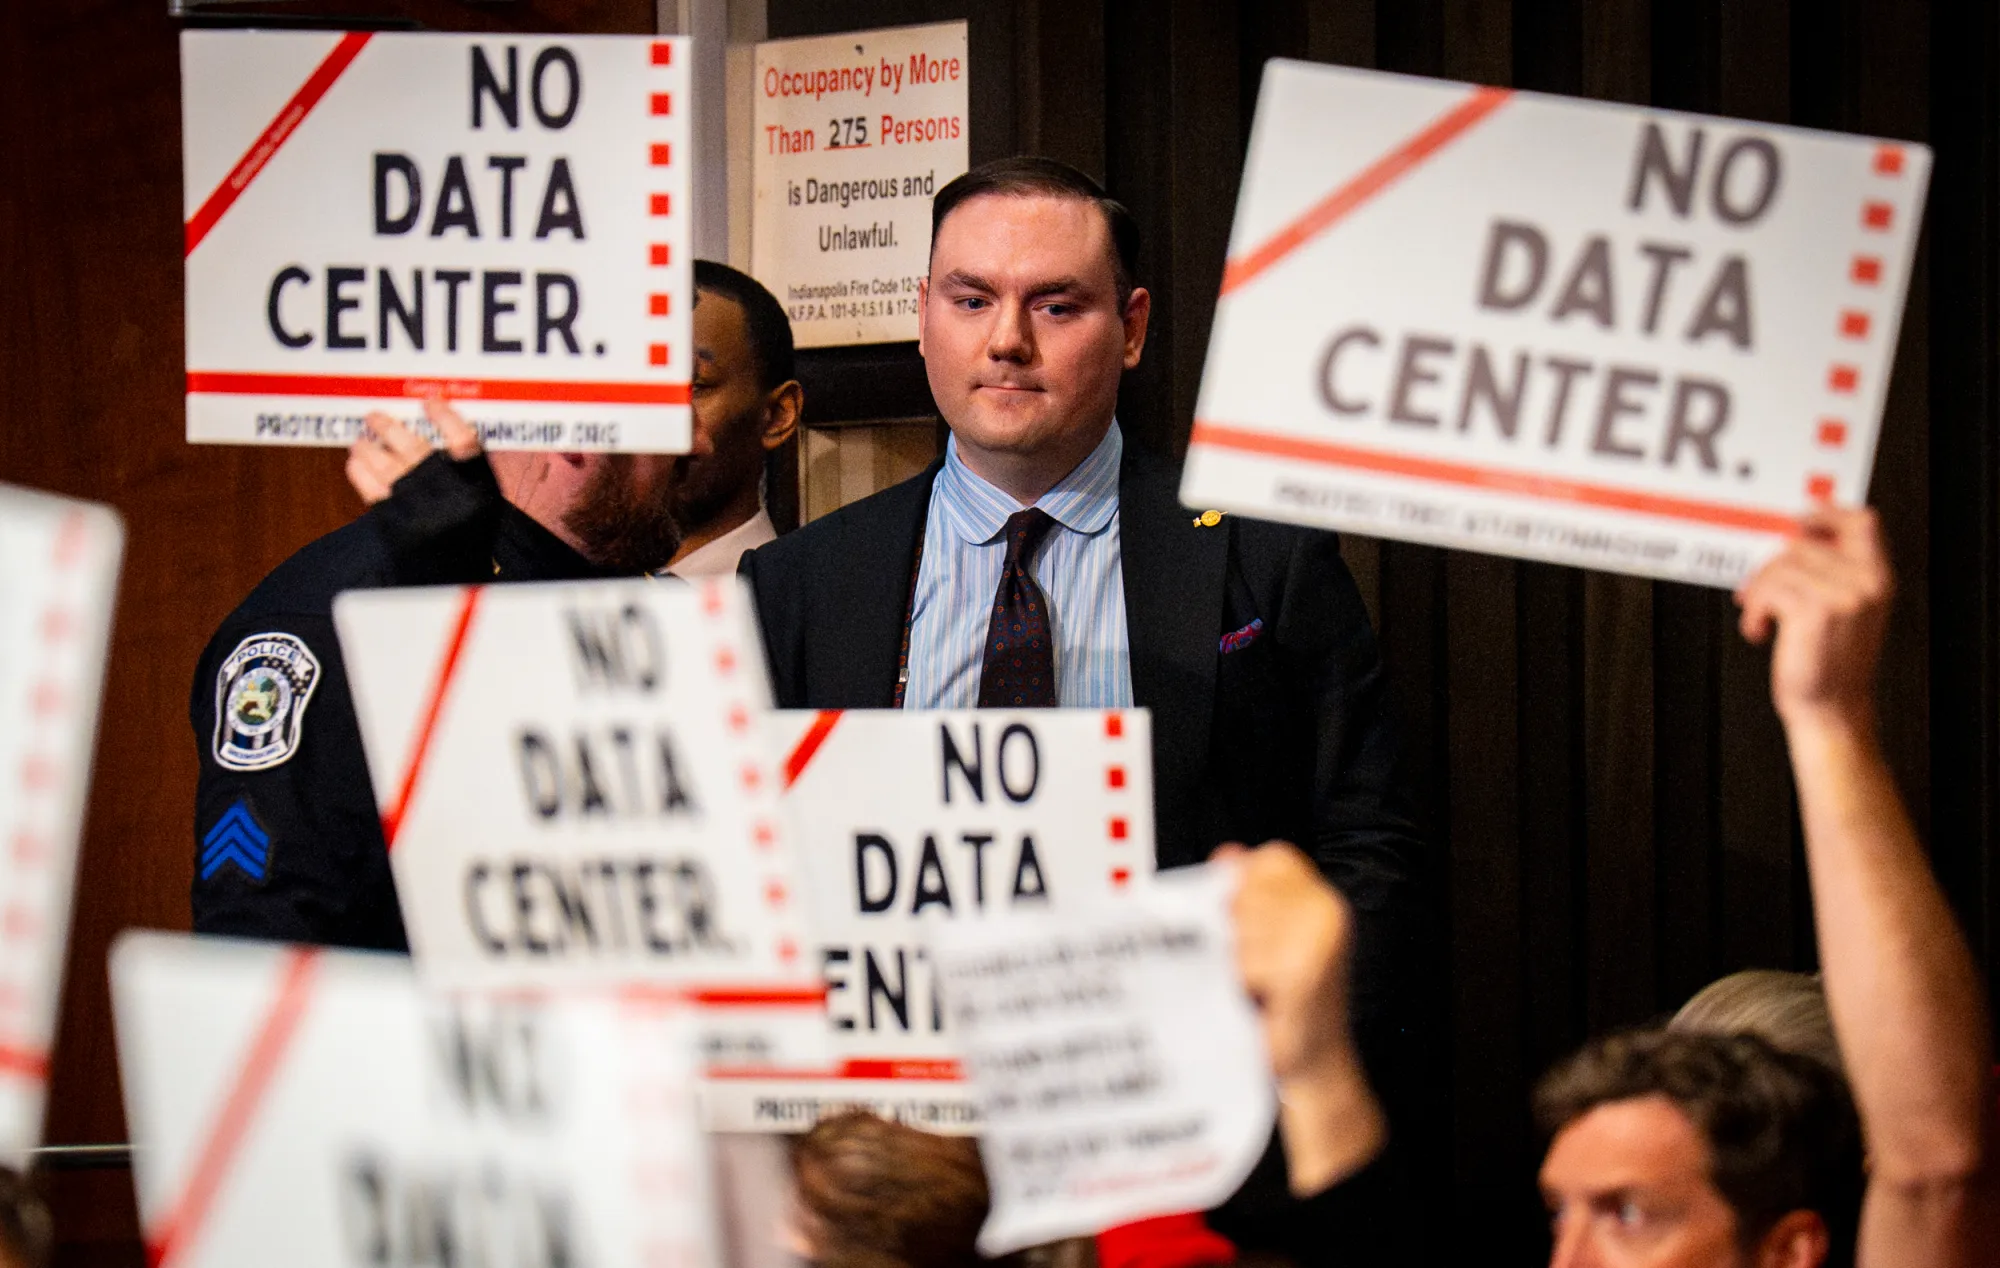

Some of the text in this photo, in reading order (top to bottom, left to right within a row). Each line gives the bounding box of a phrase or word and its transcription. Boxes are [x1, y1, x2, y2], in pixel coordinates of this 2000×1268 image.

[469, 45, 582, 131] NO
[763, 52, 961, 101] Occupancy by More
[765, 115, 961, 155] Than 275 Persons
[1628, 121, 1783, 229] NO
[373, 152, 586, 240] DATA
[788, 169, 935, 209] is Dangerous and
[819, 221, 899, 252] Unlawful.
[266, 265, 607, 356] CENTER.
[788, 281, 848, 301] Indianapolis
[850, 279, 869, 296] Fire
[872, 278, 898, 294] Code
[1475, 217, 1757, 353] DATA
[1315, 327, 1756, 481] CENTER.
[236, 644, 297, 663] POLICE
[512, 722, 702, 828] DATA
[940, 722, 1041, 804] NO
[855, 833, 1049, 914] DATA
